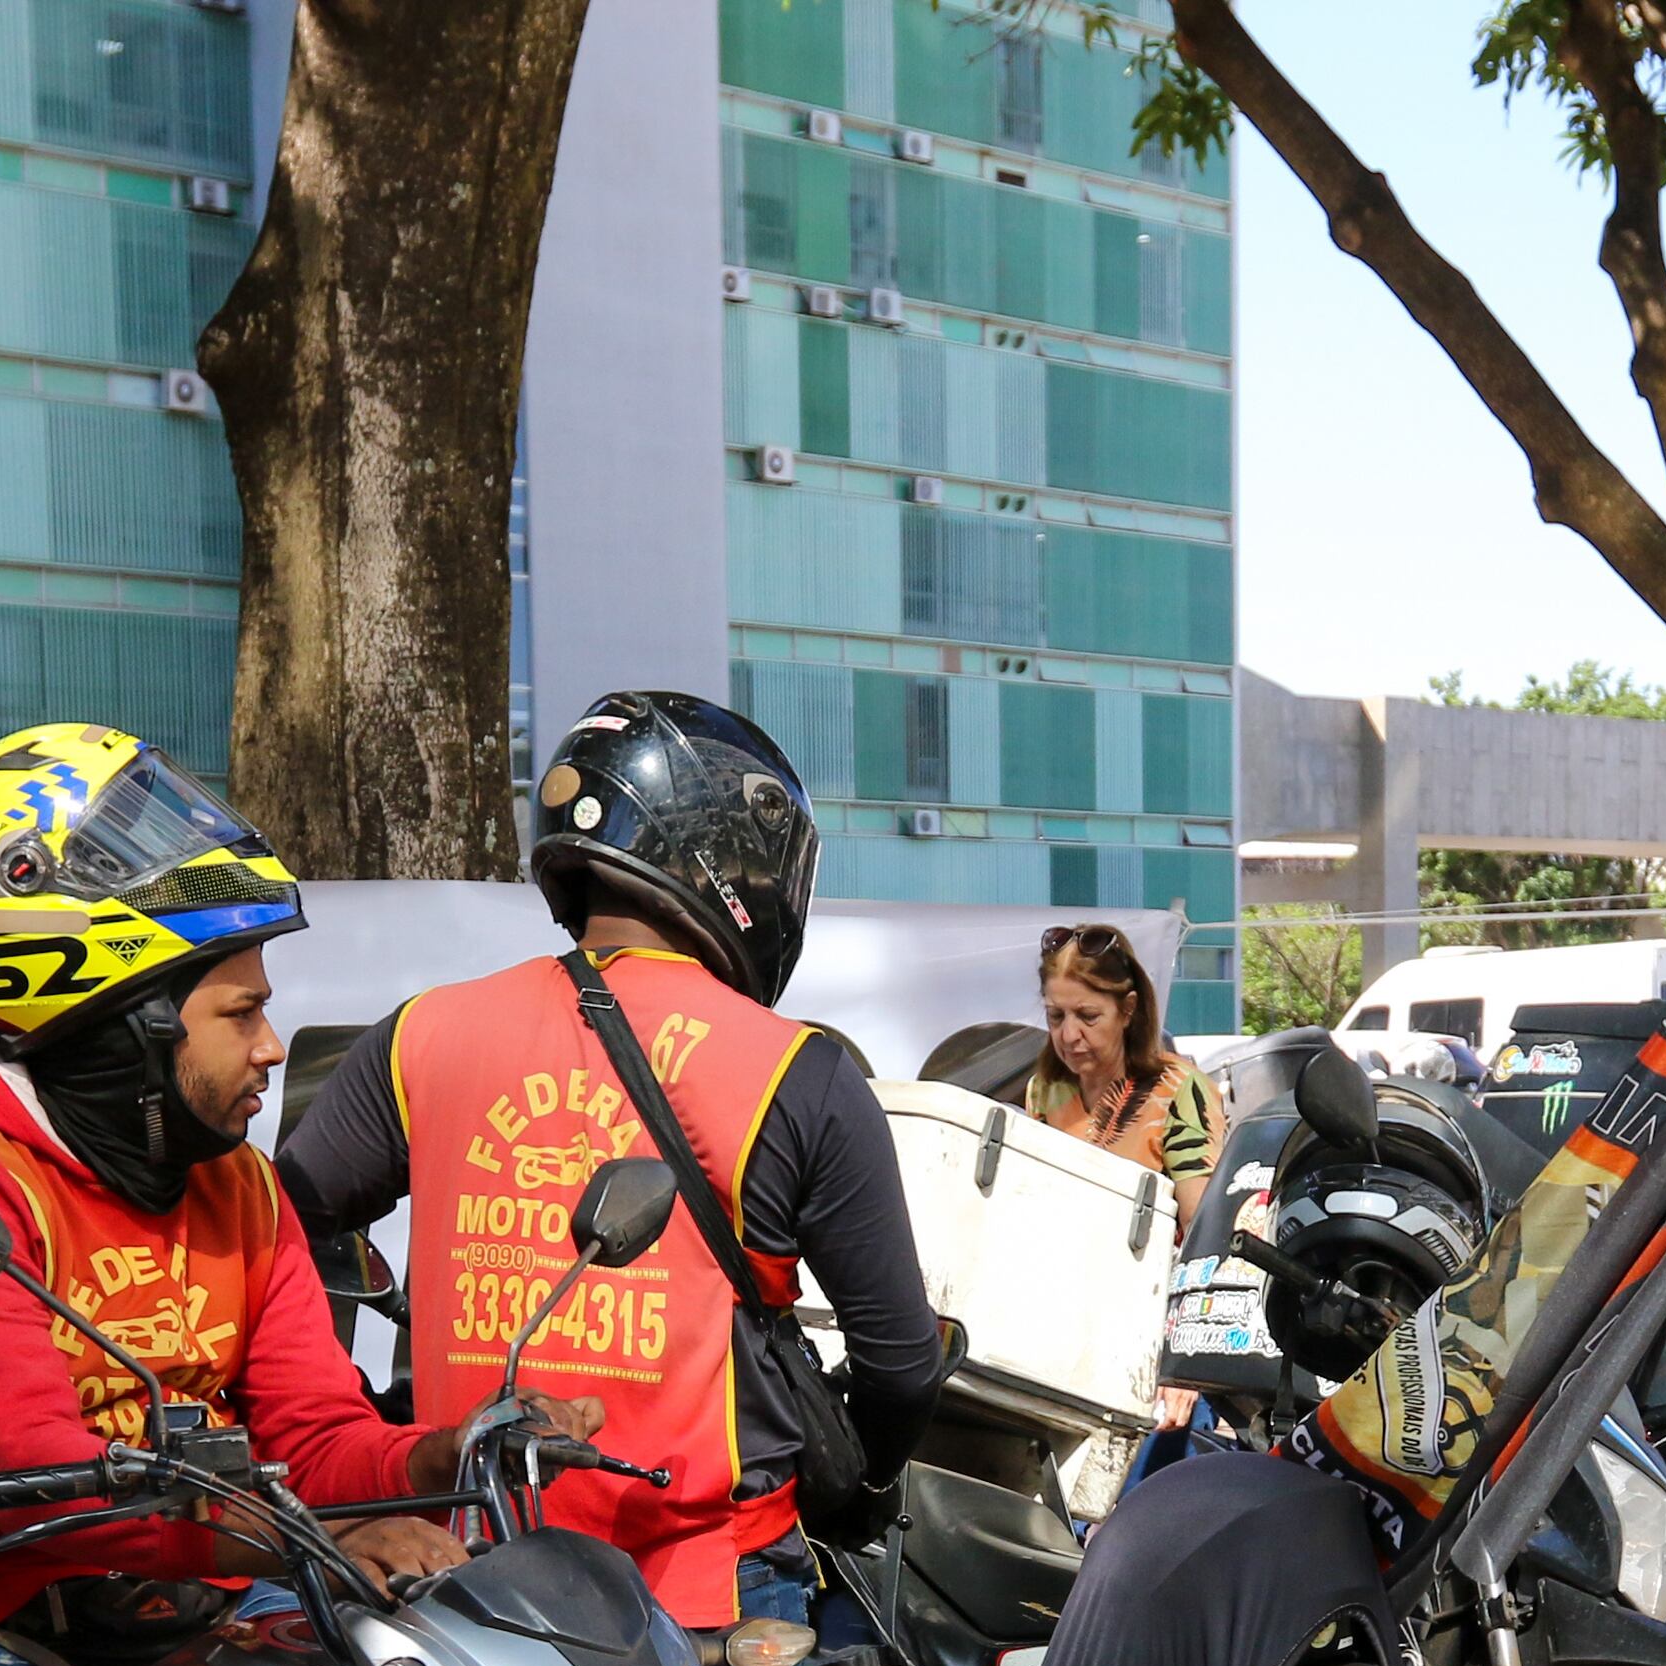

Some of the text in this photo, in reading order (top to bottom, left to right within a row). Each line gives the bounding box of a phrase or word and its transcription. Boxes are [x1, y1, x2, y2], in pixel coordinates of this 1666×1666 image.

[651, 1012, 712, 1084] 67
[465, 1069, 641, 1175] FEDERA
[456, 1194, 570, 1244] MOTO
[465, 1243, 536, 1276] (9090)
[453, 1272, 668, 1360] 3339-4315
